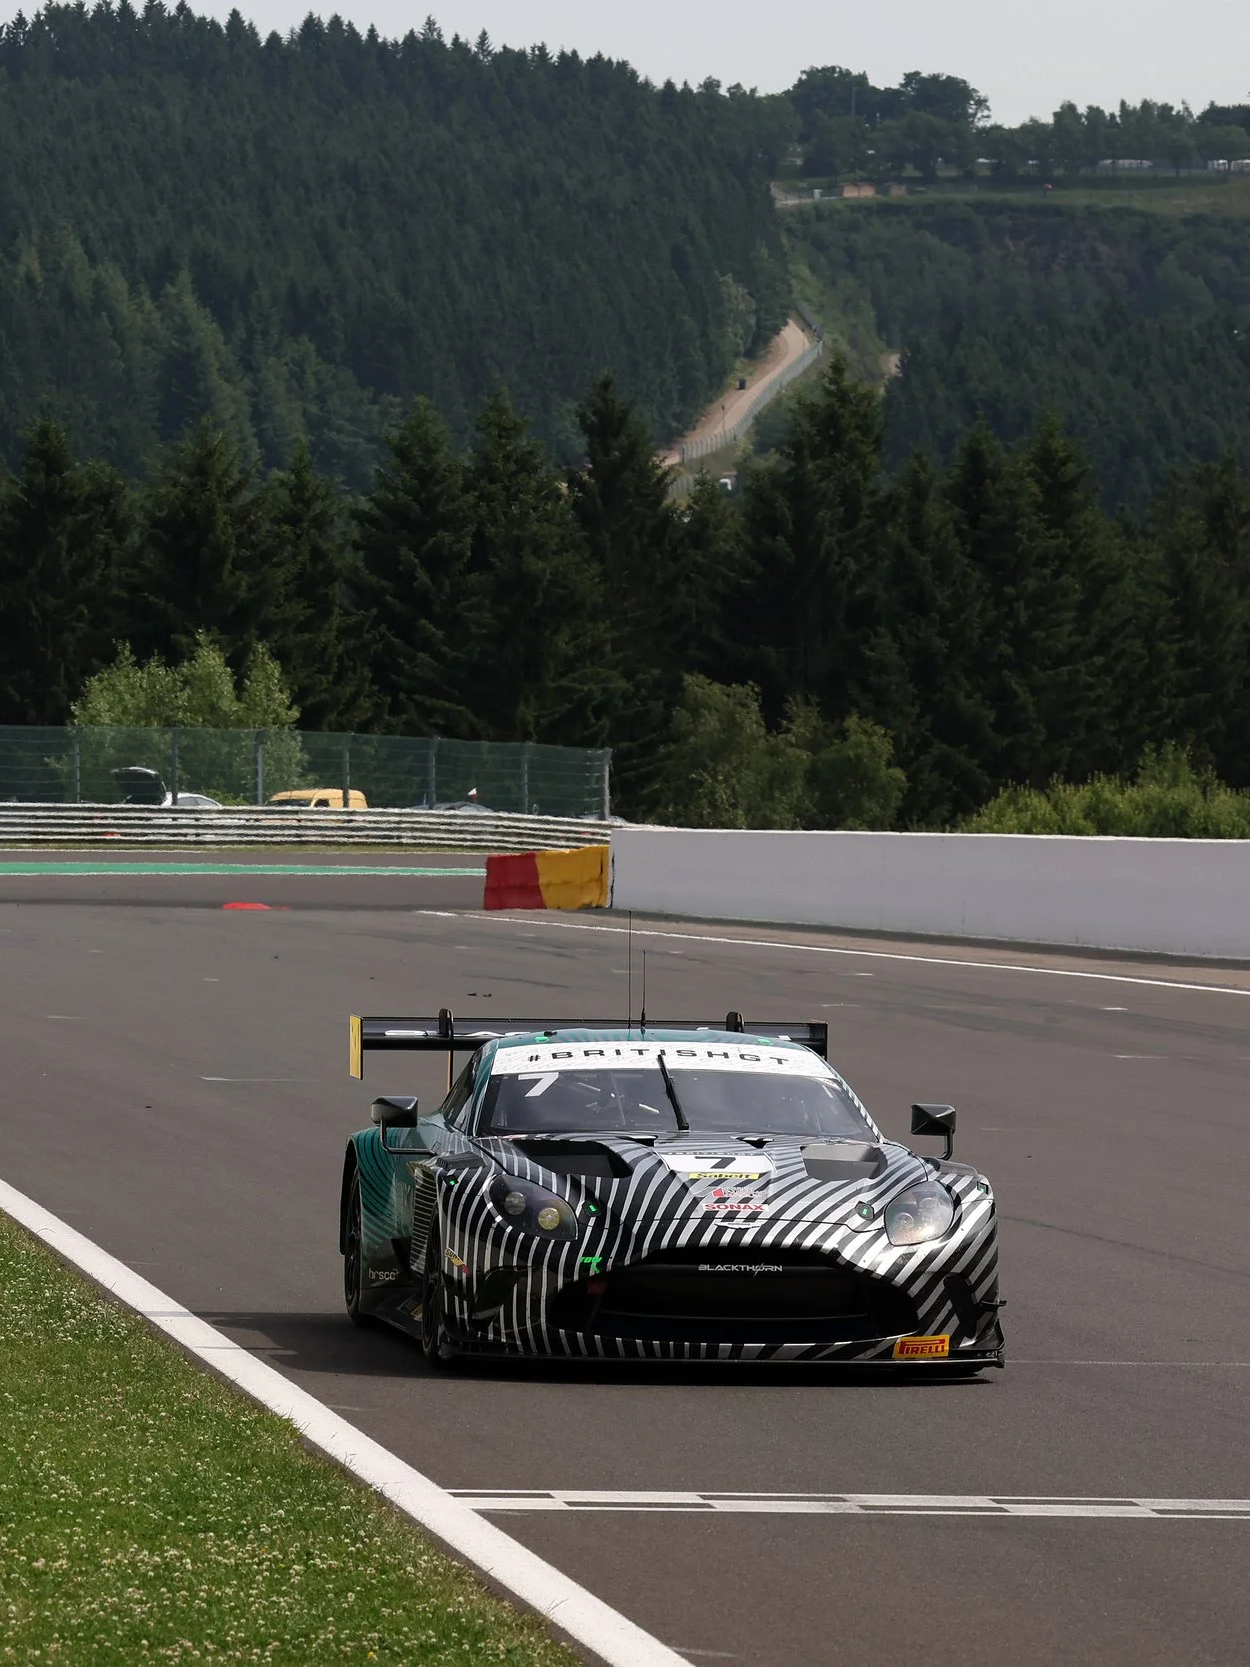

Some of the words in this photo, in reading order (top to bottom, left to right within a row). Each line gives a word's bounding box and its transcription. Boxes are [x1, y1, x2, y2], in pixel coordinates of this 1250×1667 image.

[527, 1048, 789, 1065] #BRITISHGT
[518, 1072, 559, 1097] 7
[694, 1156, 736, 1169] 7
[898, 1338, 946, 1354] PIRELLI
